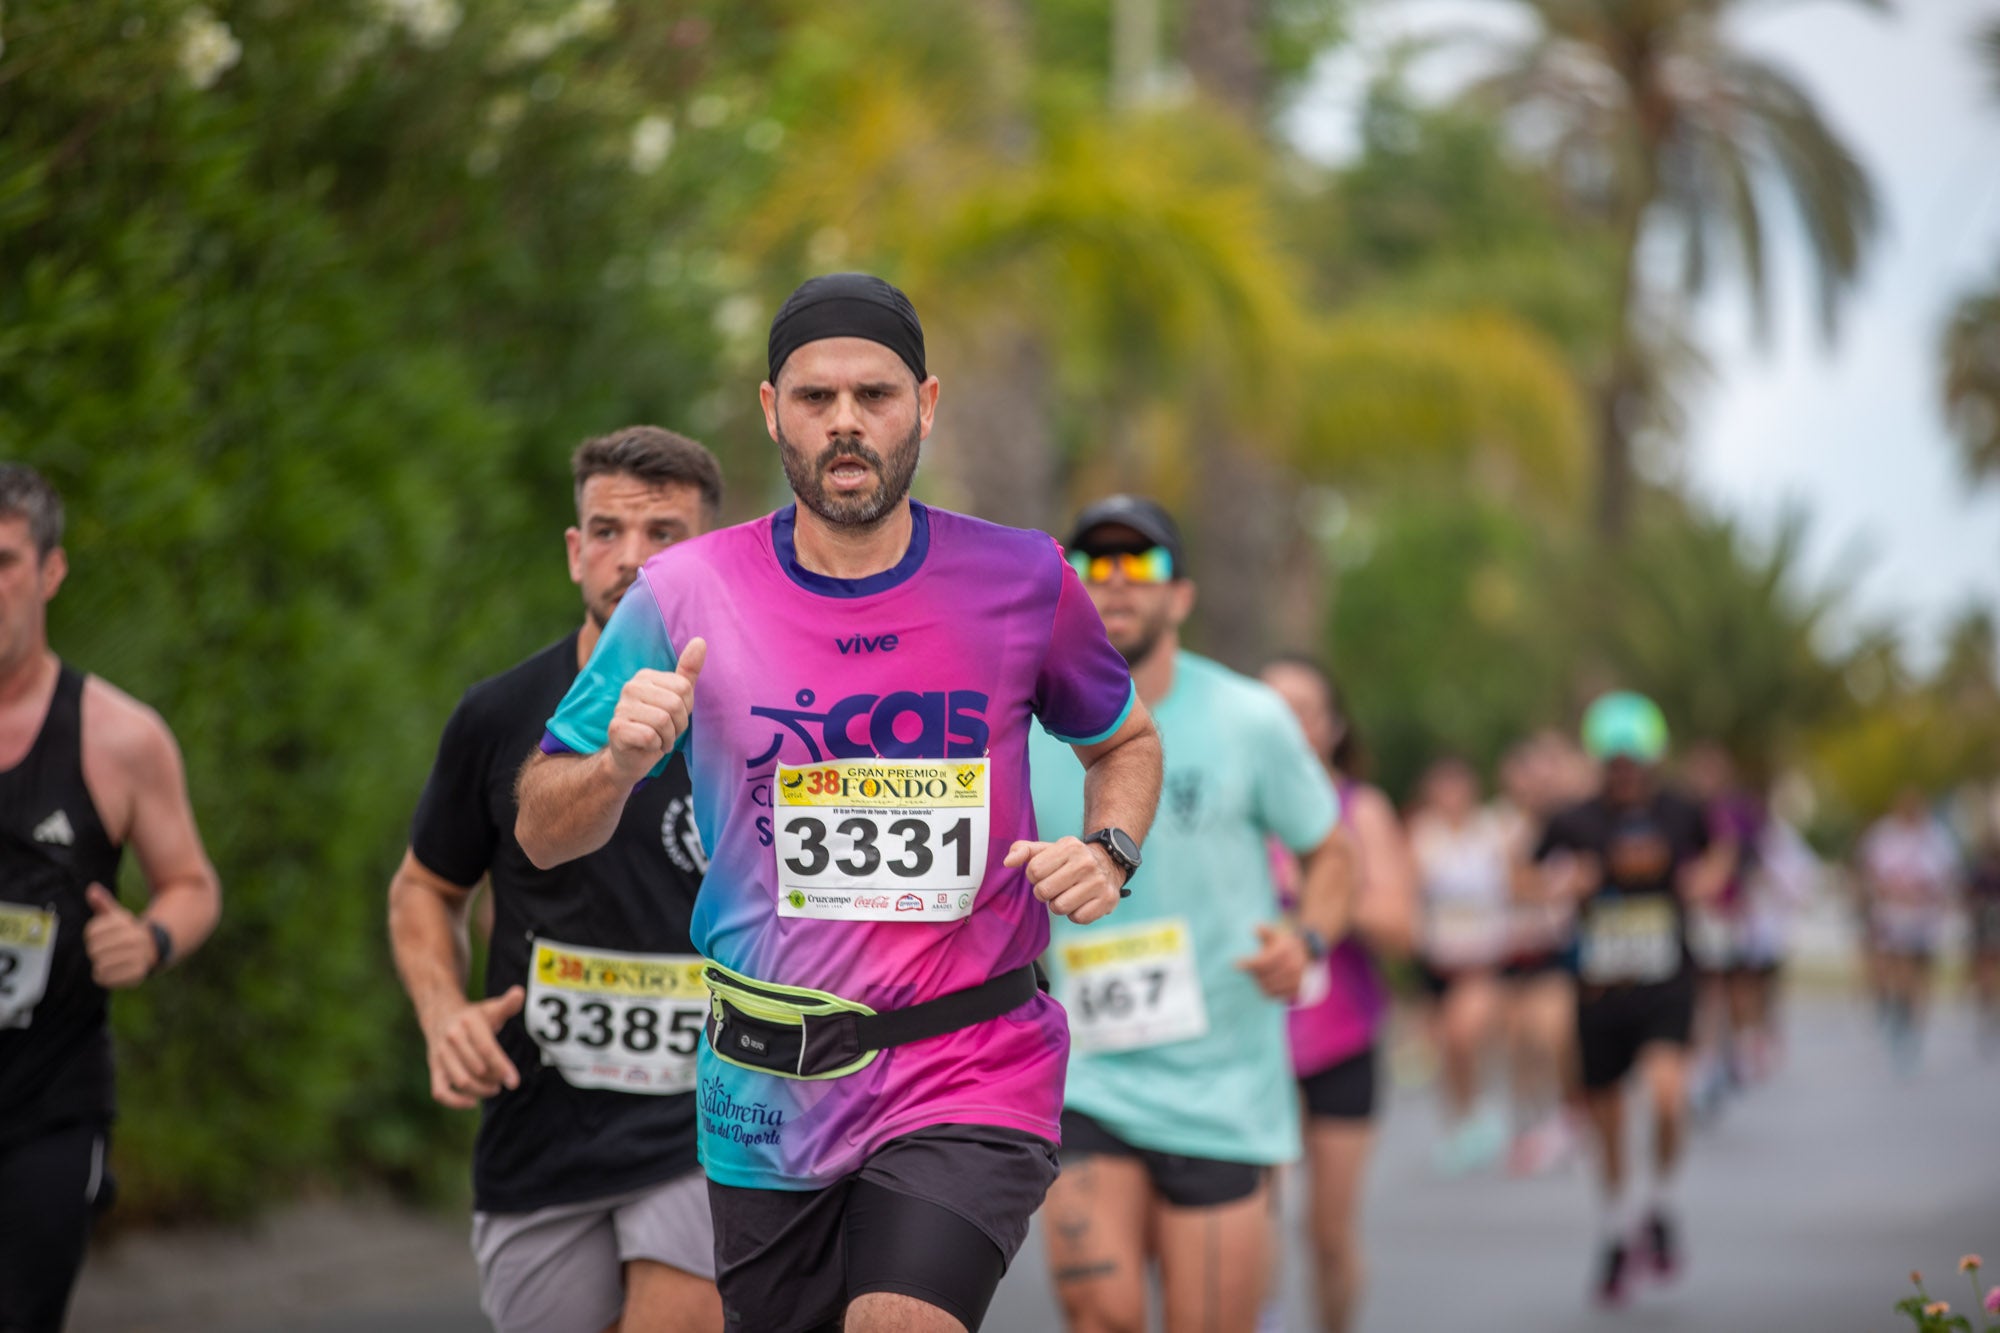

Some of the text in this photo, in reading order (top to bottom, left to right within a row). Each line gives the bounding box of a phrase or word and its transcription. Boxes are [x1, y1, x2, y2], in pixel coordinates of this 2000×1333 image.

[834, 633, 899, 654] vive
[823, 690, 989, 759] cas
[806, 769, 840, 795] 38
[847, 767, 884, 777] GRAN
[888, 768, 938, 778] PREMIO
[841, 778, 948, 799] FONDO
[784, 816, 971, 878] 3331
[807, 894, 851, 904] Cruzcampo
[537, 996, 704, 1056] 3385
[700, 1078, 785, 1127] Salobreña
[731, 1124, 781, 1148] Deporte
